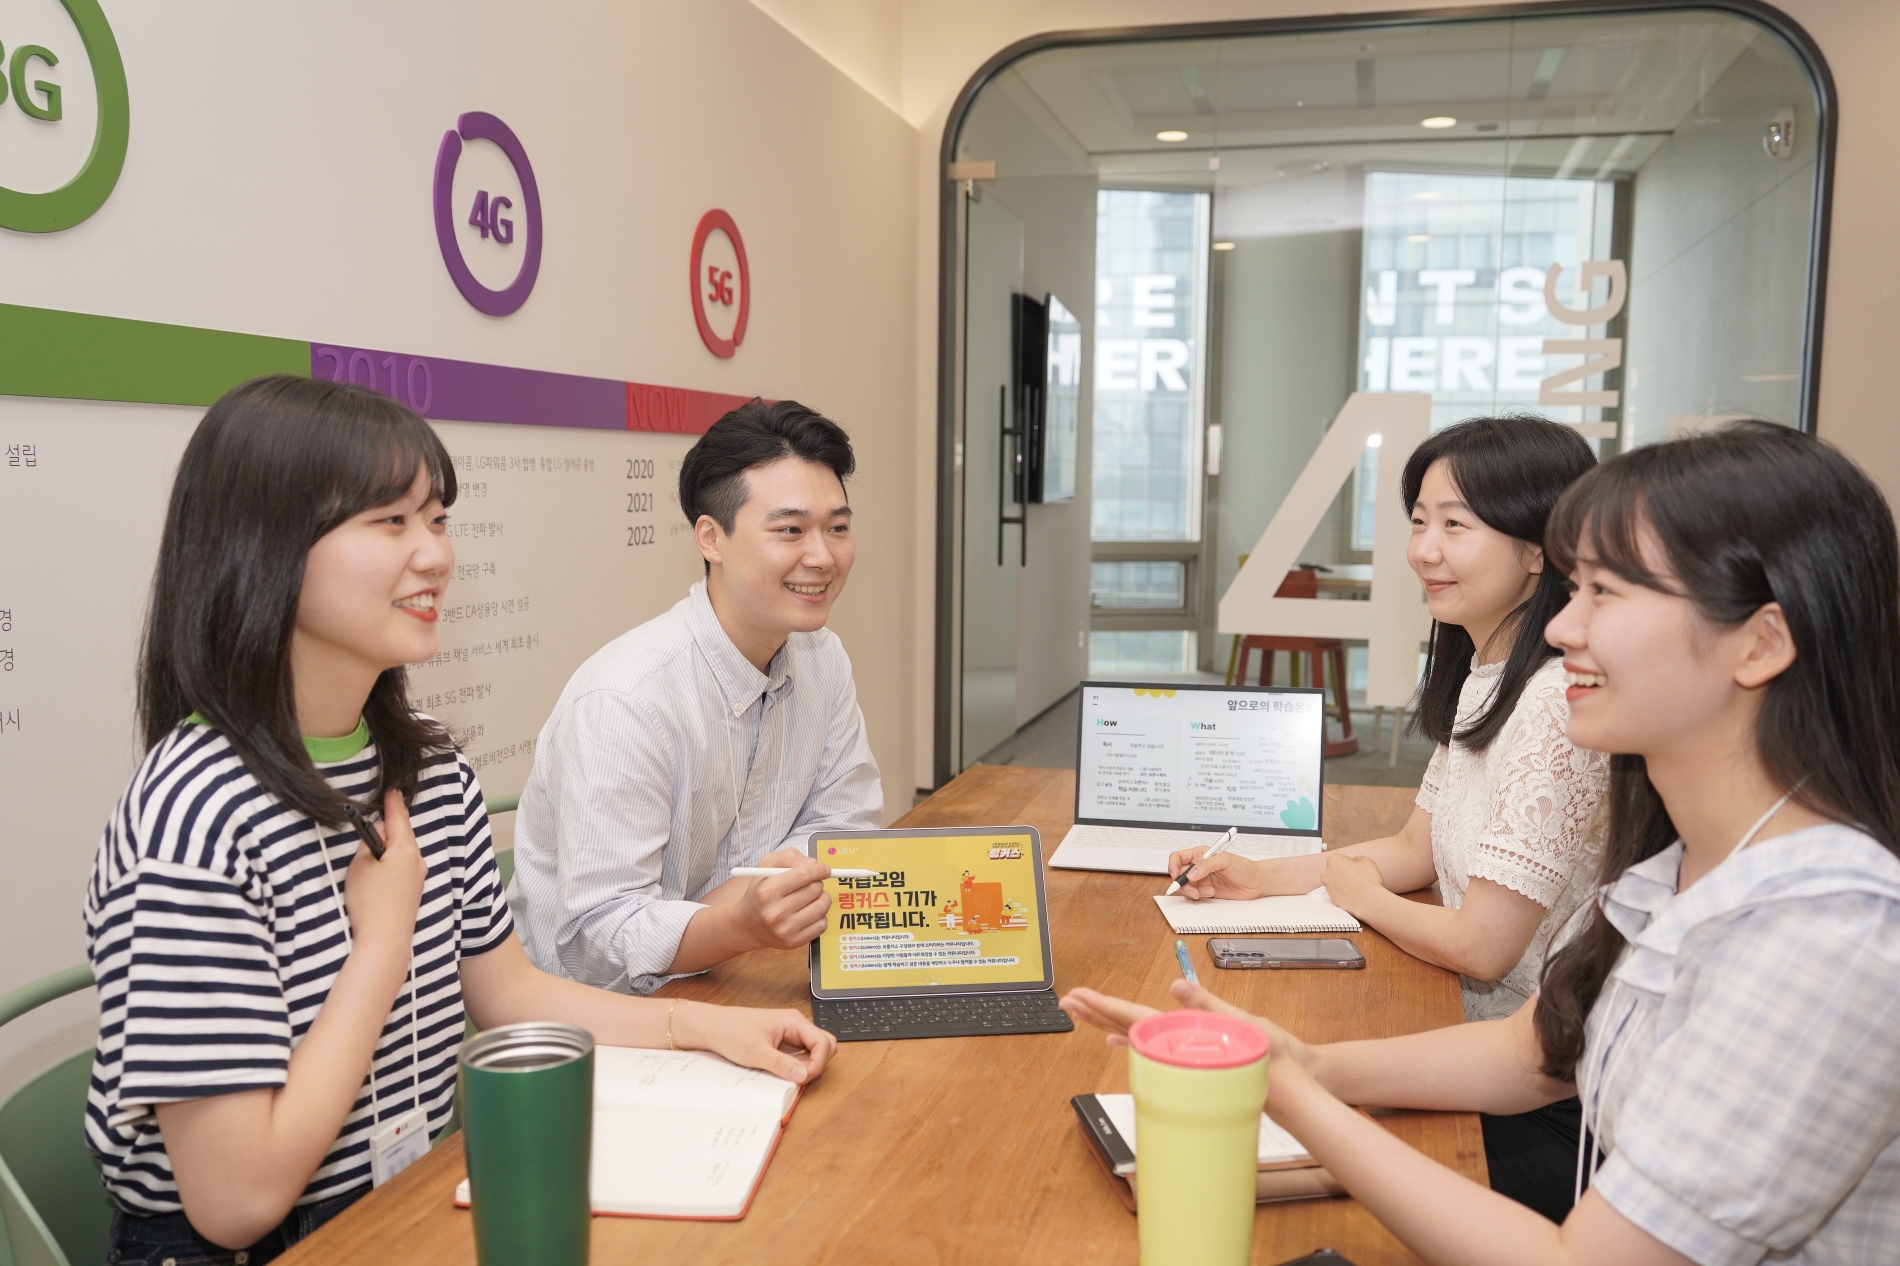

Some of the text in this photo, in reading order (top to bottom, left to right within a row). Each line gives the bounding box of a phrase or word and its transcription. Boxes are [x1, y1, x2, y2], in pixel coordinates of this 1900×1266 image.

[0, 40, 62, 121] G
[468, 189, 513, 244] 4G
[708, 265, 733, 305] 5G
[627, 382, 689, 431] NOW
[5, 444, 36, 467] 설립
[509, 457, 520, 471] 3사
[553, 458, 562, 471] LG
[626, 459, 654, 479] 2020
[472, 482, 487, 498] 변경
[627, 492, 653, 513] 2021
[454, 524, 469, 538] LTE
[471, 522, 487, 539] 전파
[488, 521, 503, 538] 발사
[627, 525, 655, 546] 2022
[1218, 392, 1432, 706] 4
[457, 563, 480, 580] 전국망
[482, 562, 496, 577] 구축
[442, 596, 530, 623] 3밴드 CA상용망 시연 성공
[453, 647, 469, 663] 채널
[470, 642, 493, 658] 서비스
[425, 693, 443, 710] 최초
[444, 690, 457, 705] 5G
[459, 685, 475, 704] 전파
[476, 681, 492, 700] 발사
[1227, 699, 1270, 712] 앞으로의
[1096, 718, 1118, 727] How
[1190, 721, 1217, 731] What
[519, 741, 532, 756] 사명
[838, 890, 937, 909] 링커스 1기가
[839, 911, 929, 929] 시작됩니다.
